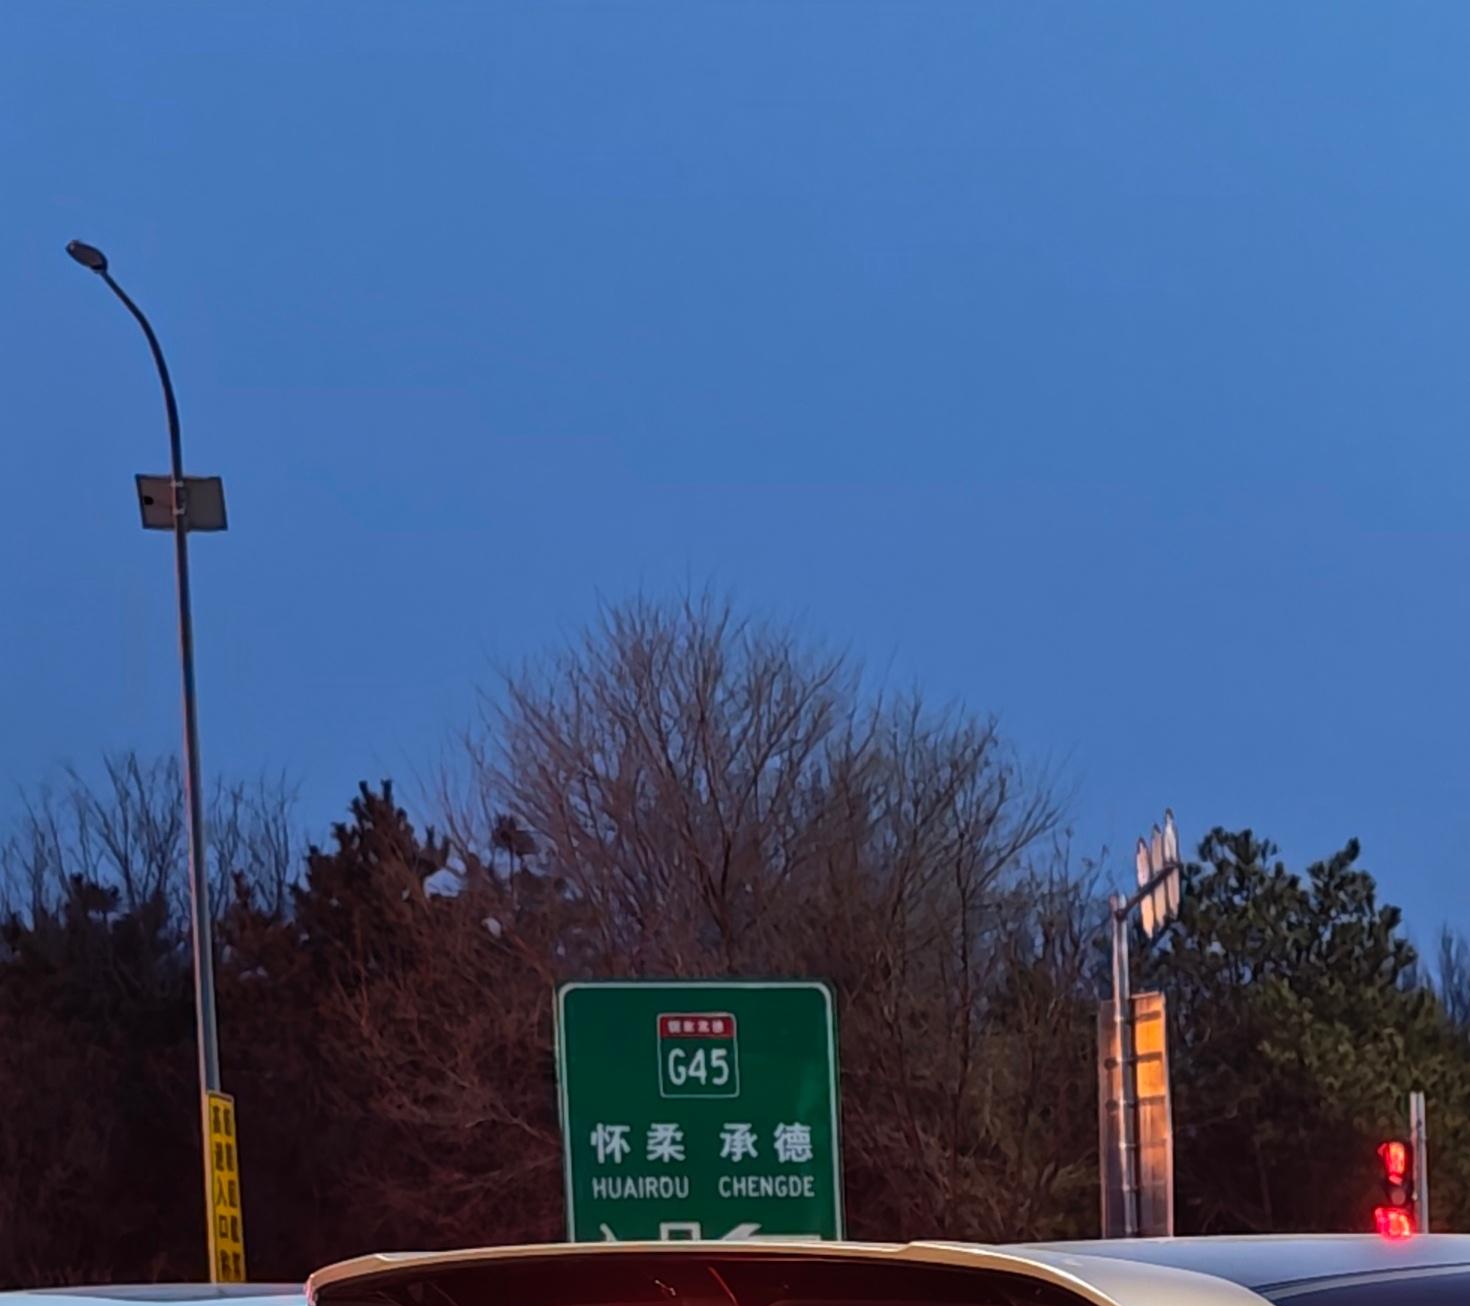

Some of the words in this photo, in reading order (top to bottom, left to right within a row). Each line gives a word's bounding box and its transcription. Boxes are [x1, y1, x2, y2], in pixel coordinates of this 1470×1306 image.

[667, 1049, 729, 1086] G45
[590, 1123, 686, 1163] 怀柔
[719, 1123, 813, 1163] 承德
[592, 1176, 689, 1199] HUAIROU
[718, 1176, 815, 1198] CHENGDE
